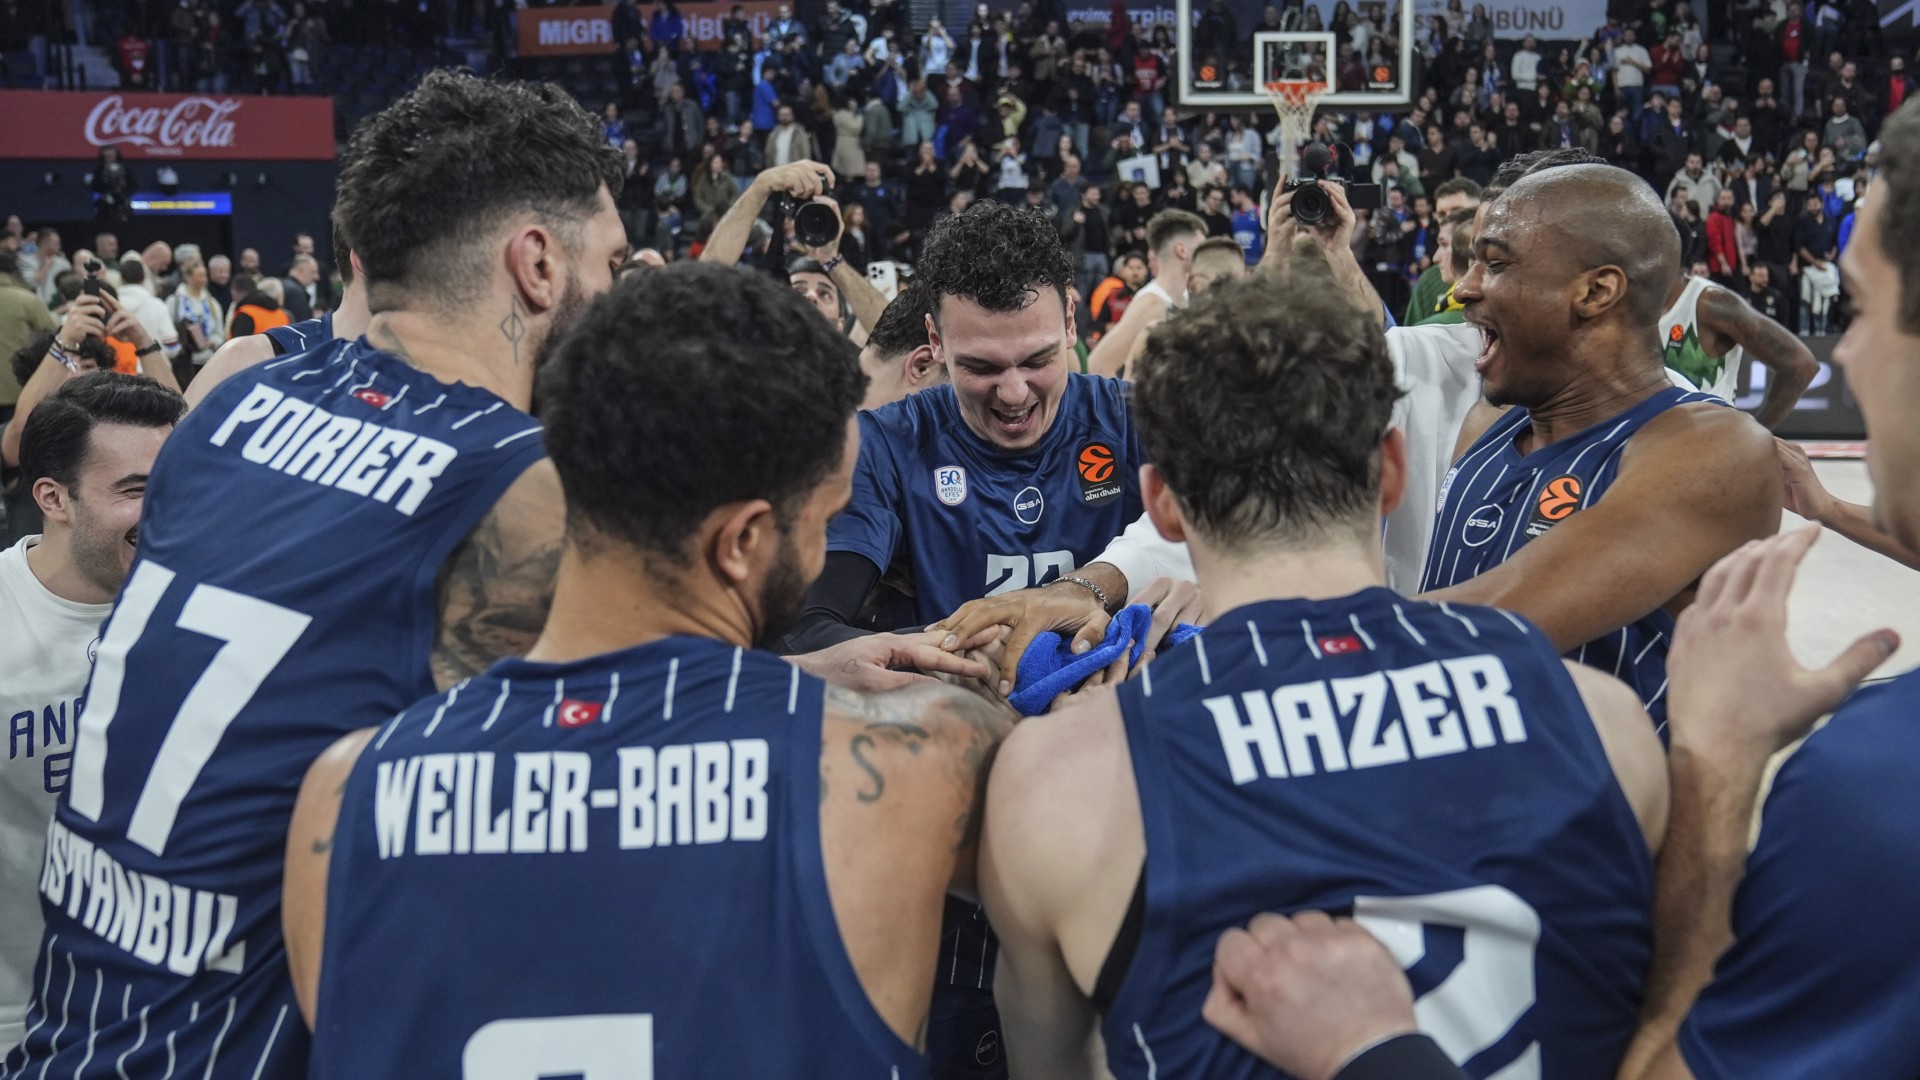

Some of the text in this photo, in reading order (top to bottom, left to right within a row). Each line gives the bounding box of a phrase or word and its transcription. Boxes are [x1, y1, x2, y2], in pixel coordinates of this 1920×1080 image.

[84, 95, 242, 146] Coca-Cola
[209, 382, 458, 517] POIRIER
[940, 470, 961, 486] 50
[1016, 498, 1041, 510] GSA
[1467, 518, 1497, 529] GSA
[69, 559, 313, 857] 17
[1202, 654, 1527, 785] HAZER
[375, 739, 769, 859] WEILER-BABB
